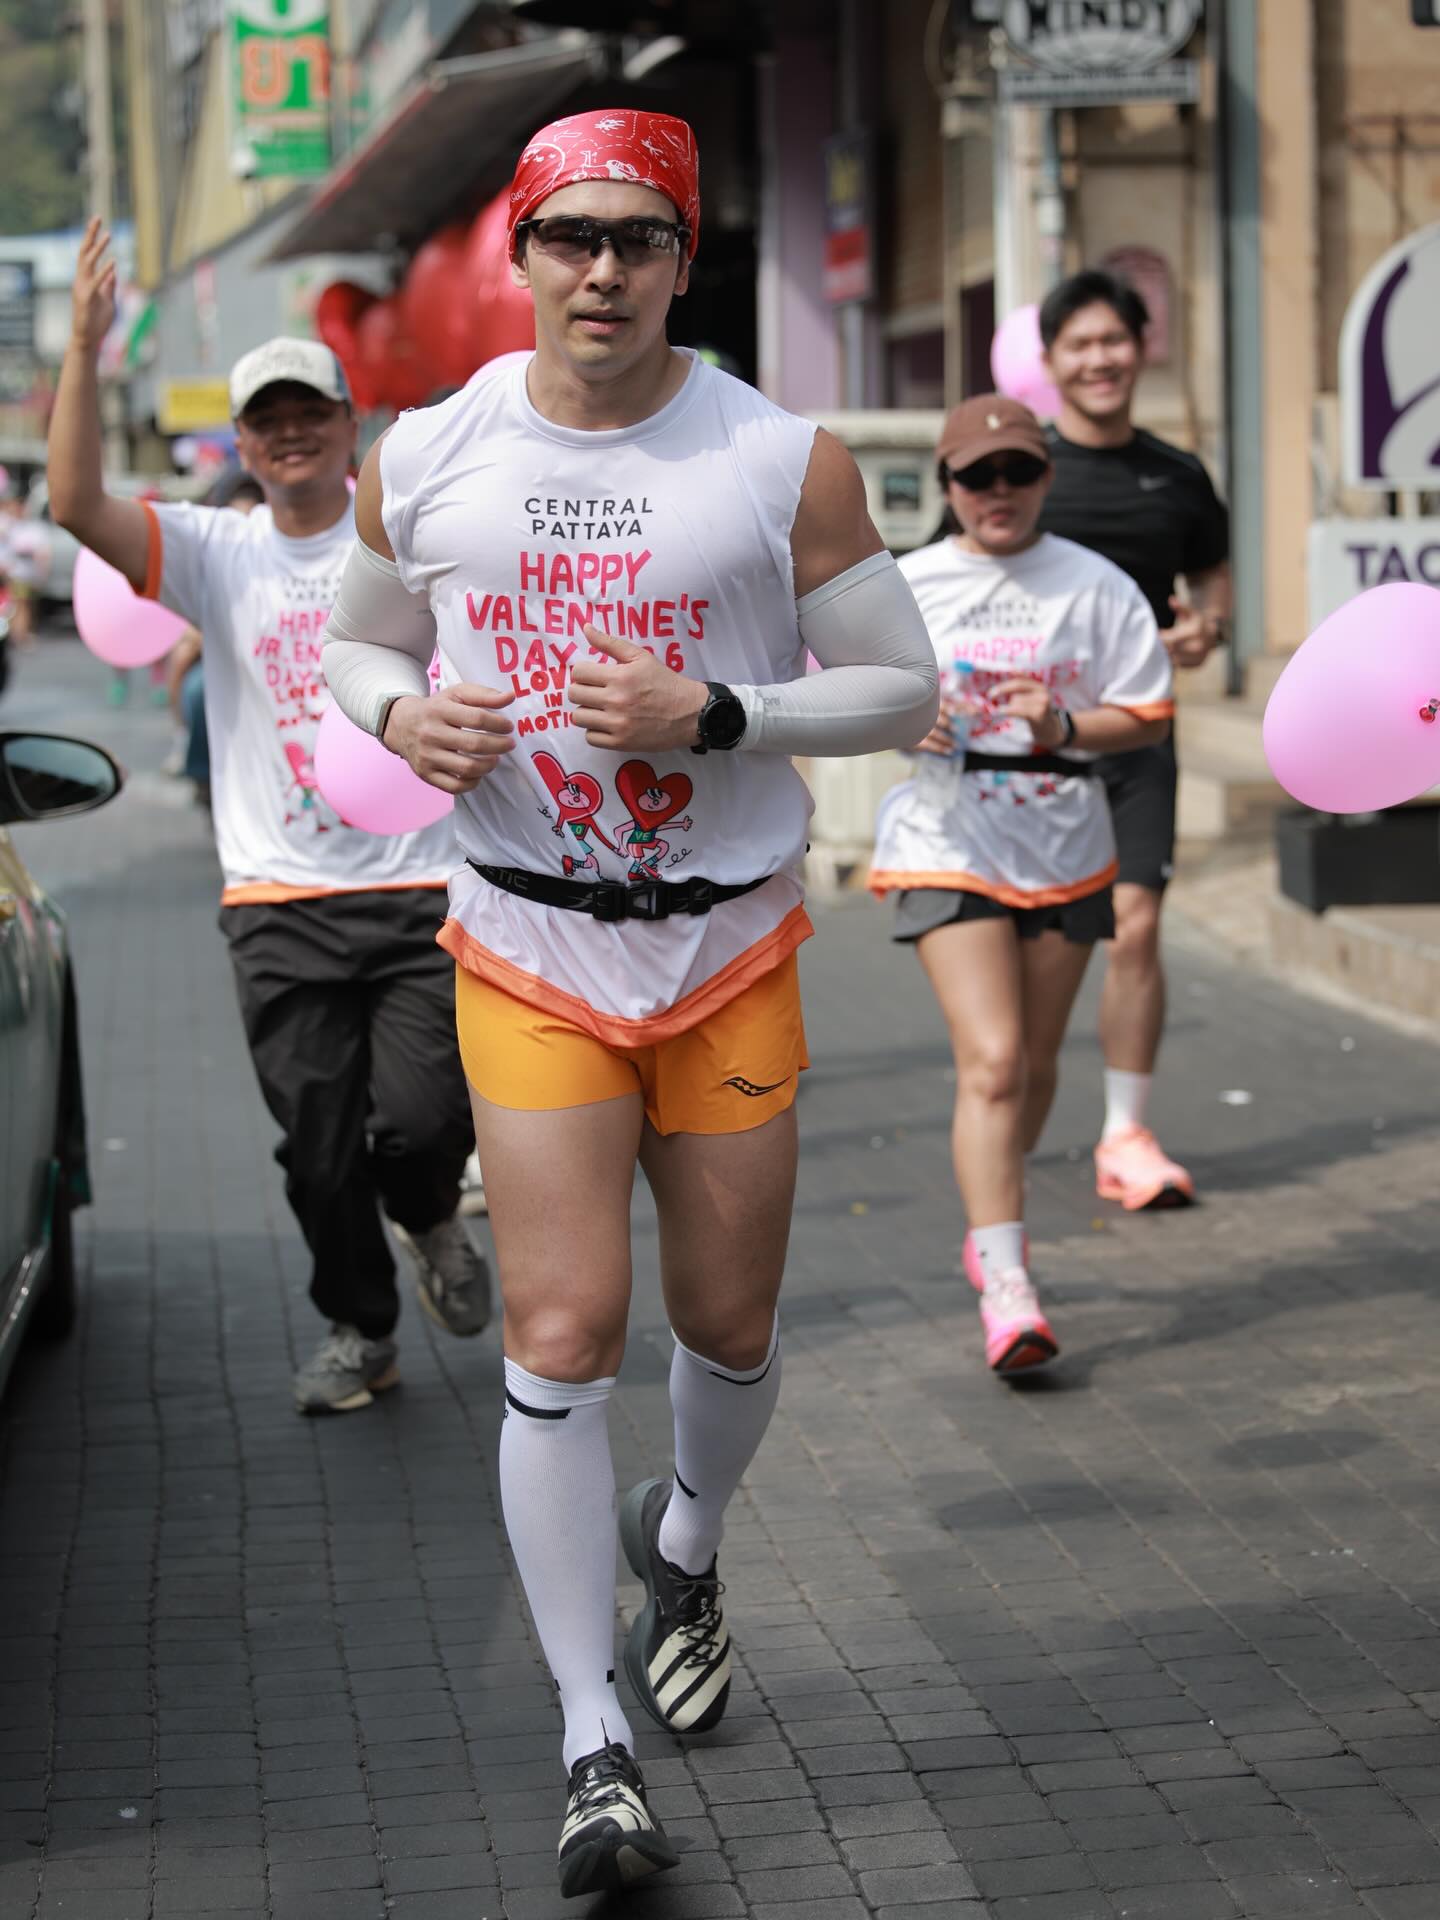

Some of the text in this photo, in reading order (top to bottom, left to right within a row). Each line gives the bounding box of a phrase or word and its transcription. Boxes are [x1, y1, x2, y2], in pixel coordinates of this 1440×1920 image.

[240, 34, 331, 108] ยา
[524, 496, 654, 518] CENTRAL
[532, 518, 643, 541] PATTAYA
[519, 549, 653, 598] HAPPY
[279, 608, 330, 636] HAP
[466, 593, 710, 640] VALENTINE'S
[494, 636, 685, 674] DAY 26
[954, 635, 1044, 664] HAPPY
[544, 692, 563, 708] IN
[517, 710, 576, 738] MOTI
[635, 831, 650, 841] VE
